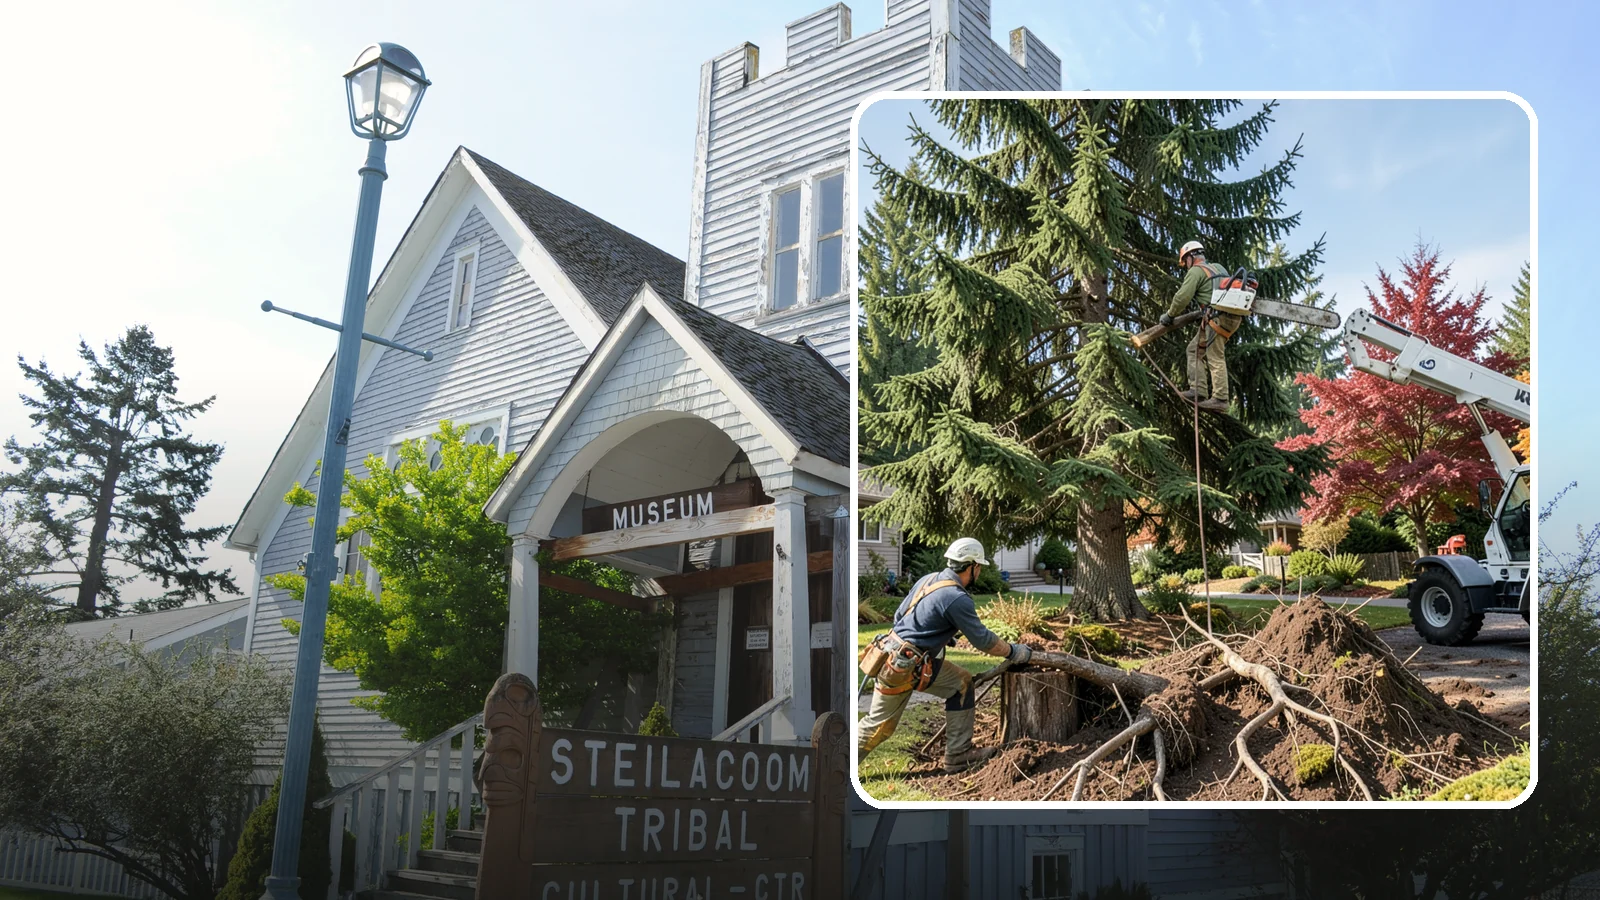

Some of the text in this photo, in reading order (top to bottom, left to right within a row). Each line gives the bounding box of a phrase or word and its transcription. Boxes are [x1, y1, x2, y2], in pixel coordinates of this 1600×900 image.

[613, 491, 714, 531] MUSEUM
[551, 738, 809, 792] STEILACOOM
[615, 807, 757, 851] TRIBAL
